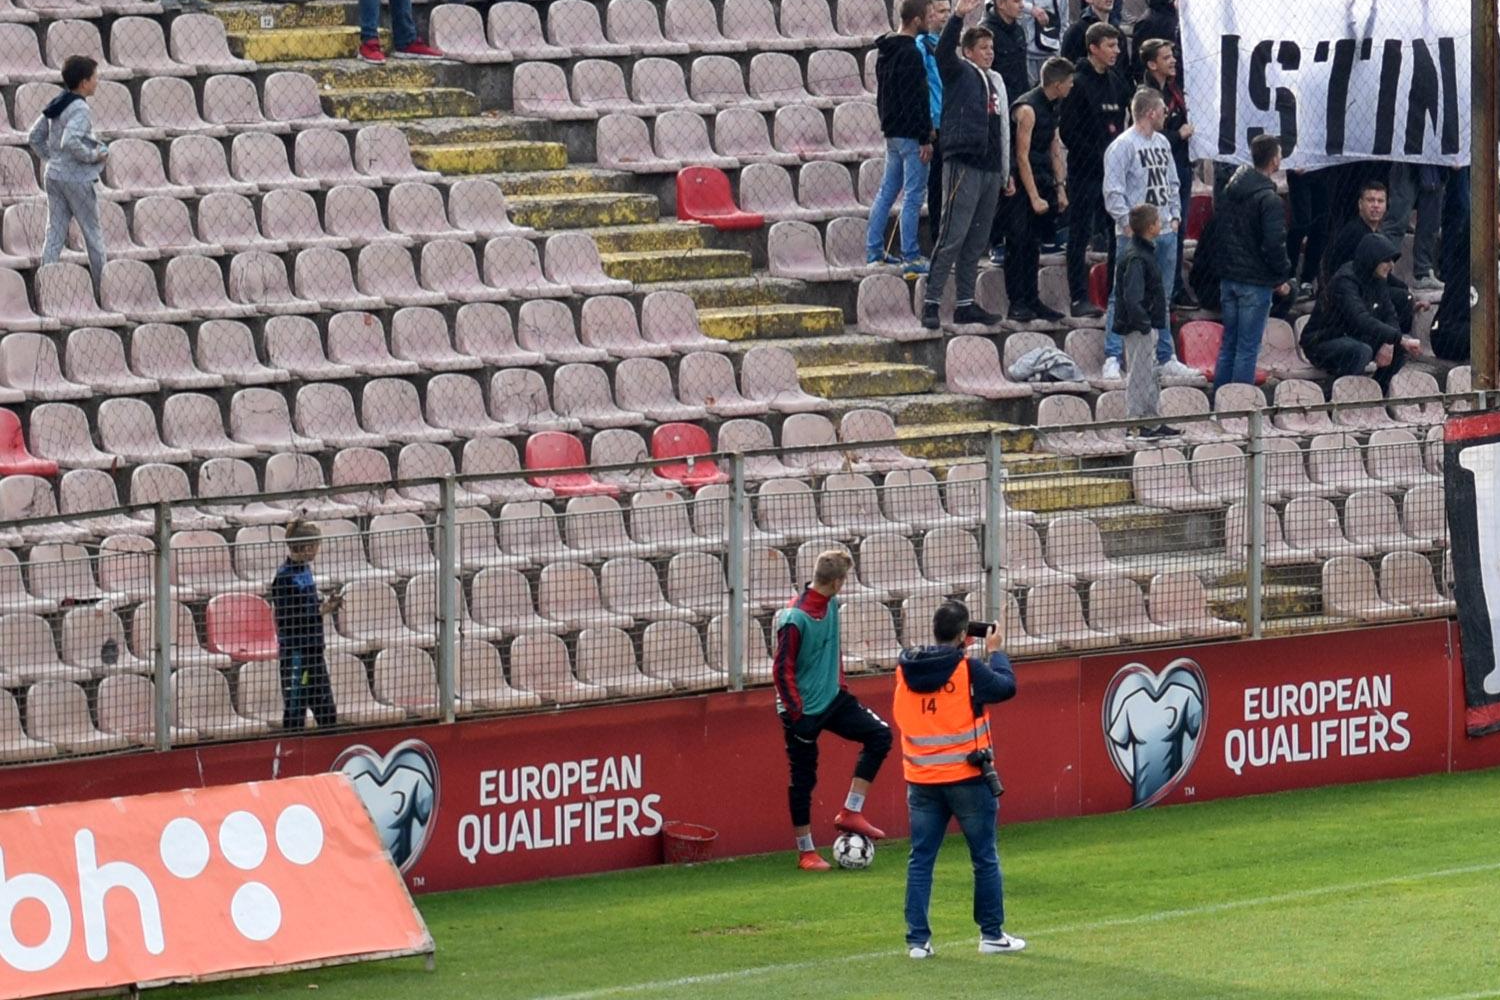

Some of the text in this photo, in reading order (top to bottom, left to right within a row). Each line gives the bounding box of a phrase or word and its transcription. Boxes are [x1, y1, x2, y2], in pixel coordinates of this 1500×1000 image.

[1138, 149, 1170, 168] KISS
[1147, 168, 1169, 187] MY
[921, 697, 938, 715] 14
[1244, 674, 1392, 721] EUROPEAN
[1224, 711, 1411, 775] QUALIFIERS
[480, 754, 642, 806] EUROPEAN
[457, 794, 664, 864] QUALIFIERS
[0, 827, 166, 973] bh
